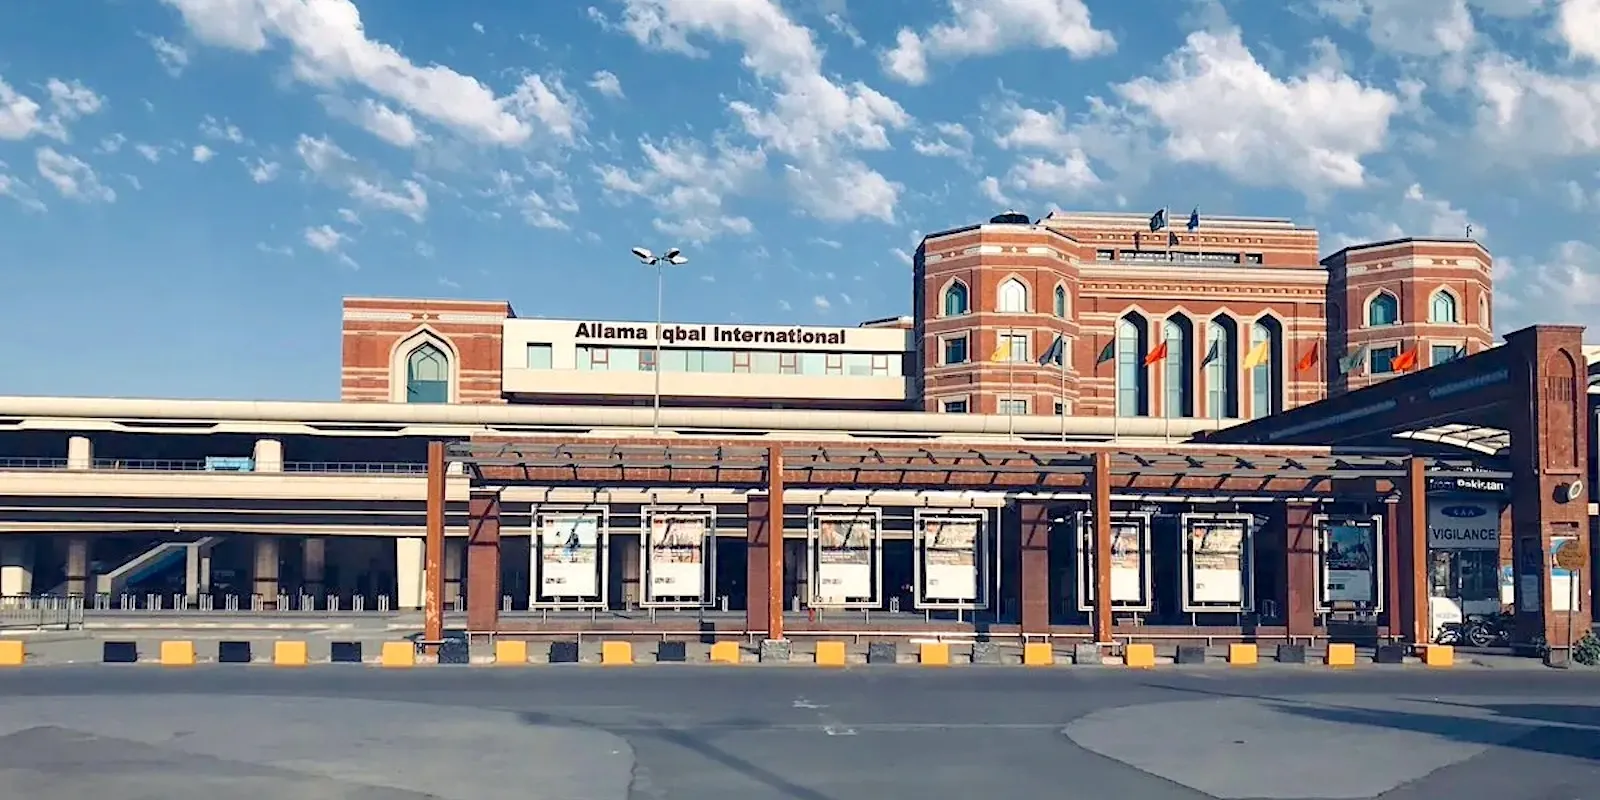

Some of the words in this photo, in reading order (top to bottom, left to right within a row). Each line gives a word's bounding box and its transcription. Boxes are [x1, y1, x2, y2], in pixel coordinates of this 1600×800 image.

[575, 322, 648, 340] Allama
[714, 326, 846, 345] International
[1433, 529, 1496, 540] VIGILANCE
